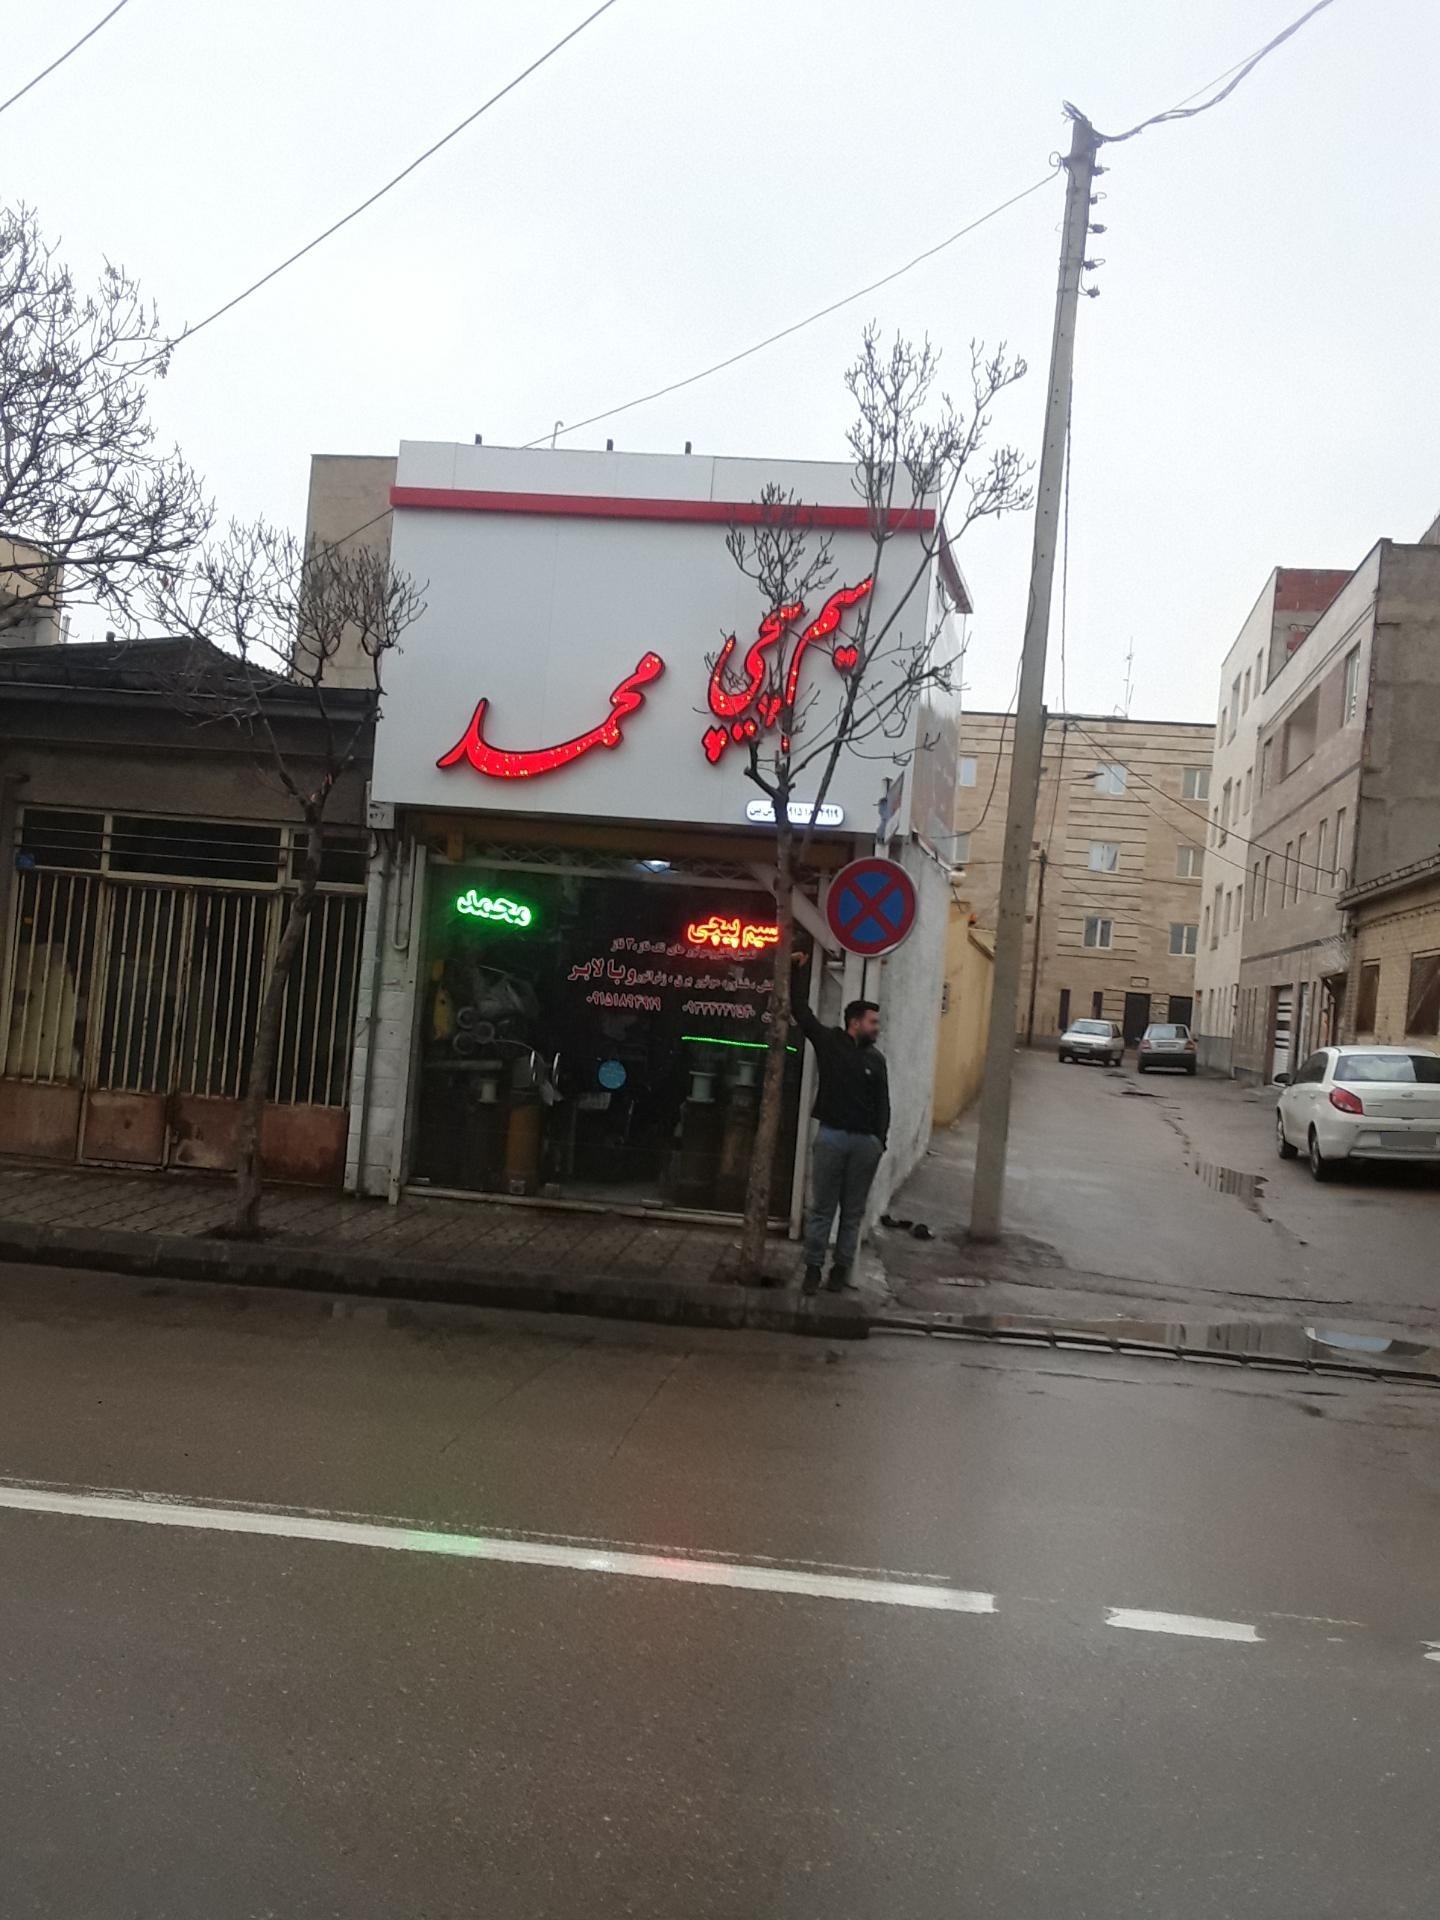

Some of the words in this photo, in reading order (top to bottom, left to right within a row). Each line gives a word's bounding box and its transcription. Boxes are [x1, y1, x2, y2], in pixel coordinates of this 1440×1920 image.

[436, 650, 665, 779] محمد
[456, 889, 532, 927] محمد
[686, 915, 741, 949] پیچی
[741, 922, 780, 949] سیم
